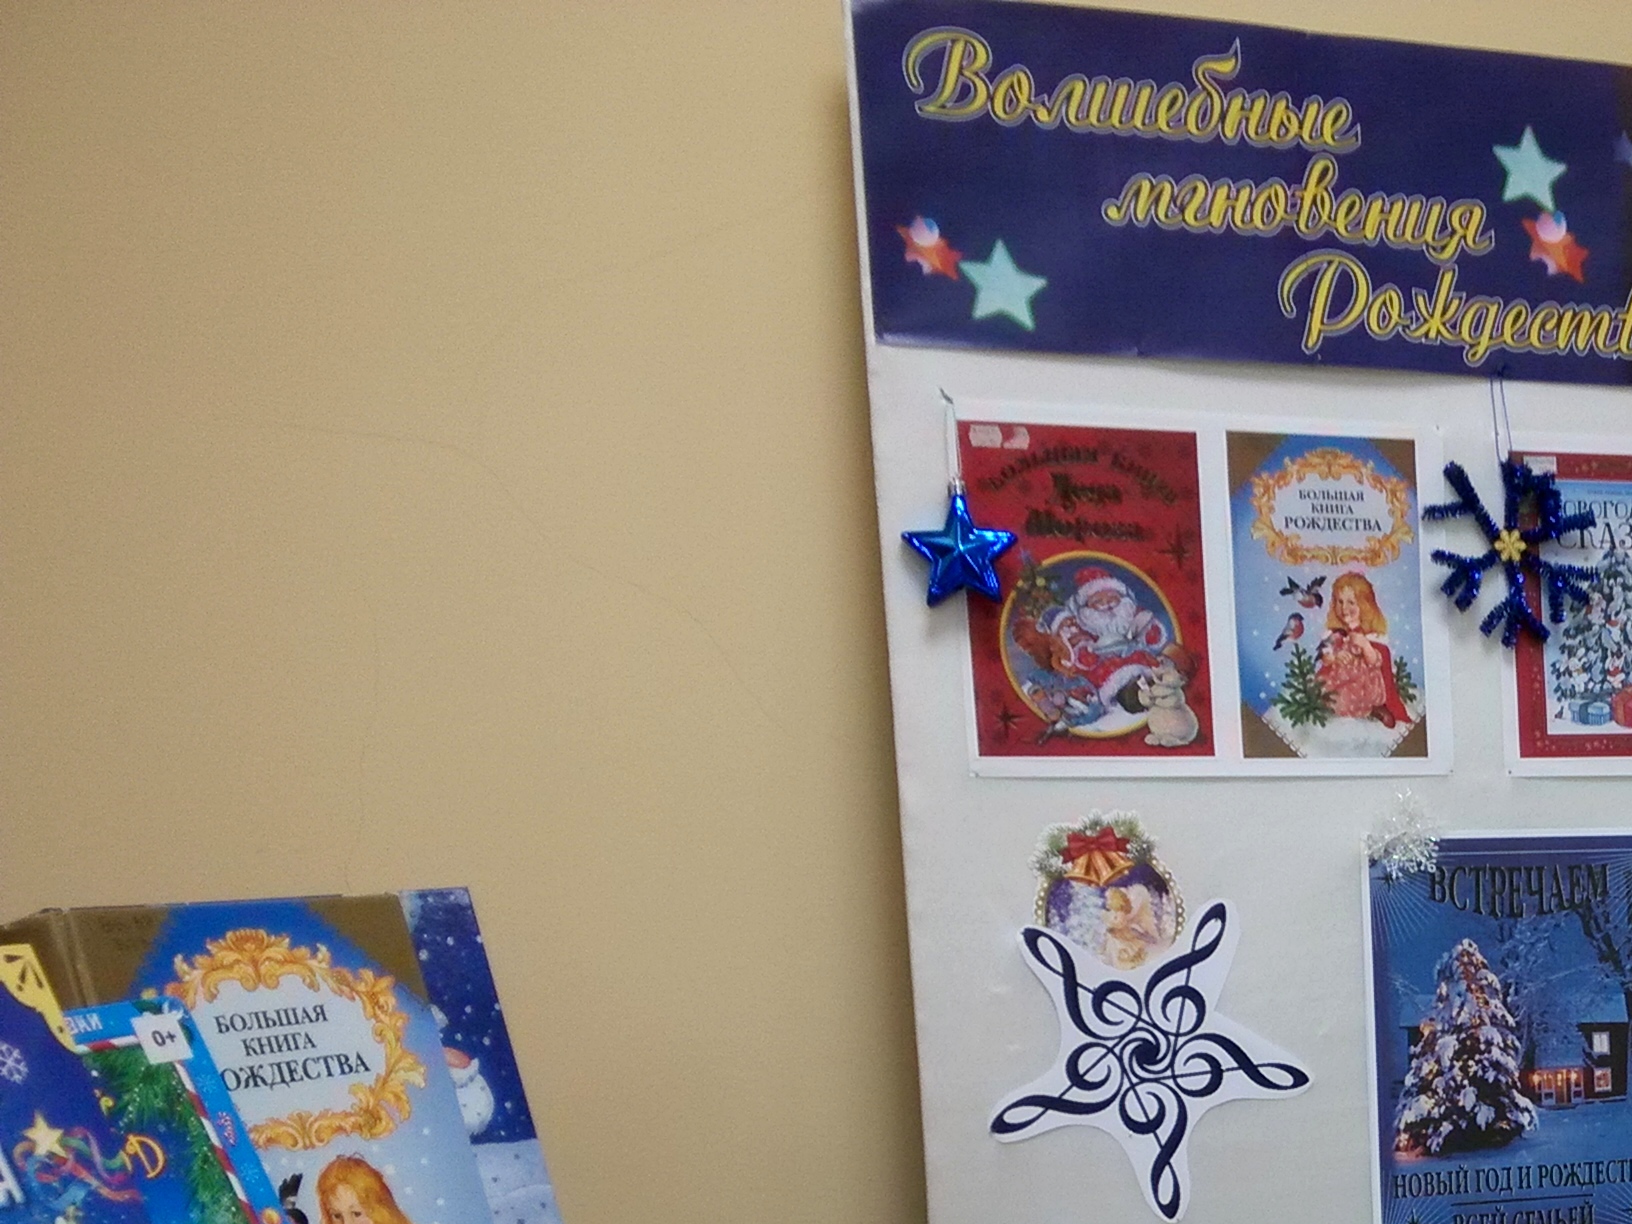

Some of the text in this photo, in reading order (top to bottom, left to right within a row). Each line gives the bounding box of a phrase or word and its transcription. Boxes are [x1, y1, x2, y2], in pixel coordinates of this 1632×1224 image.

[902, 27, 1361, 152] Волшебные
[1104, 152, 1495, 260] мгновения
[1298, 487, 1365, 503] БОЛЬШАЯ
[1311, 503, 1355, 517] КНИГА
[1284, 516, 1383, 534] РОЖДЕСТВА
[1428, 862, 1611, 919] ВСТРЕЧАЕМ
[213, 1003, 329, 1035] БОЛЬШАЯ
[240, 1031, 318, 1058] КНИГА
[221, 1050, 373, 1093] ОЖДЕСТВА
[1393, 1162, 1471, 1200] НОВЫЙ
[1475, 1165, 1513, 1195] ГОД
[1519, 1165, 1532, 1189] И
